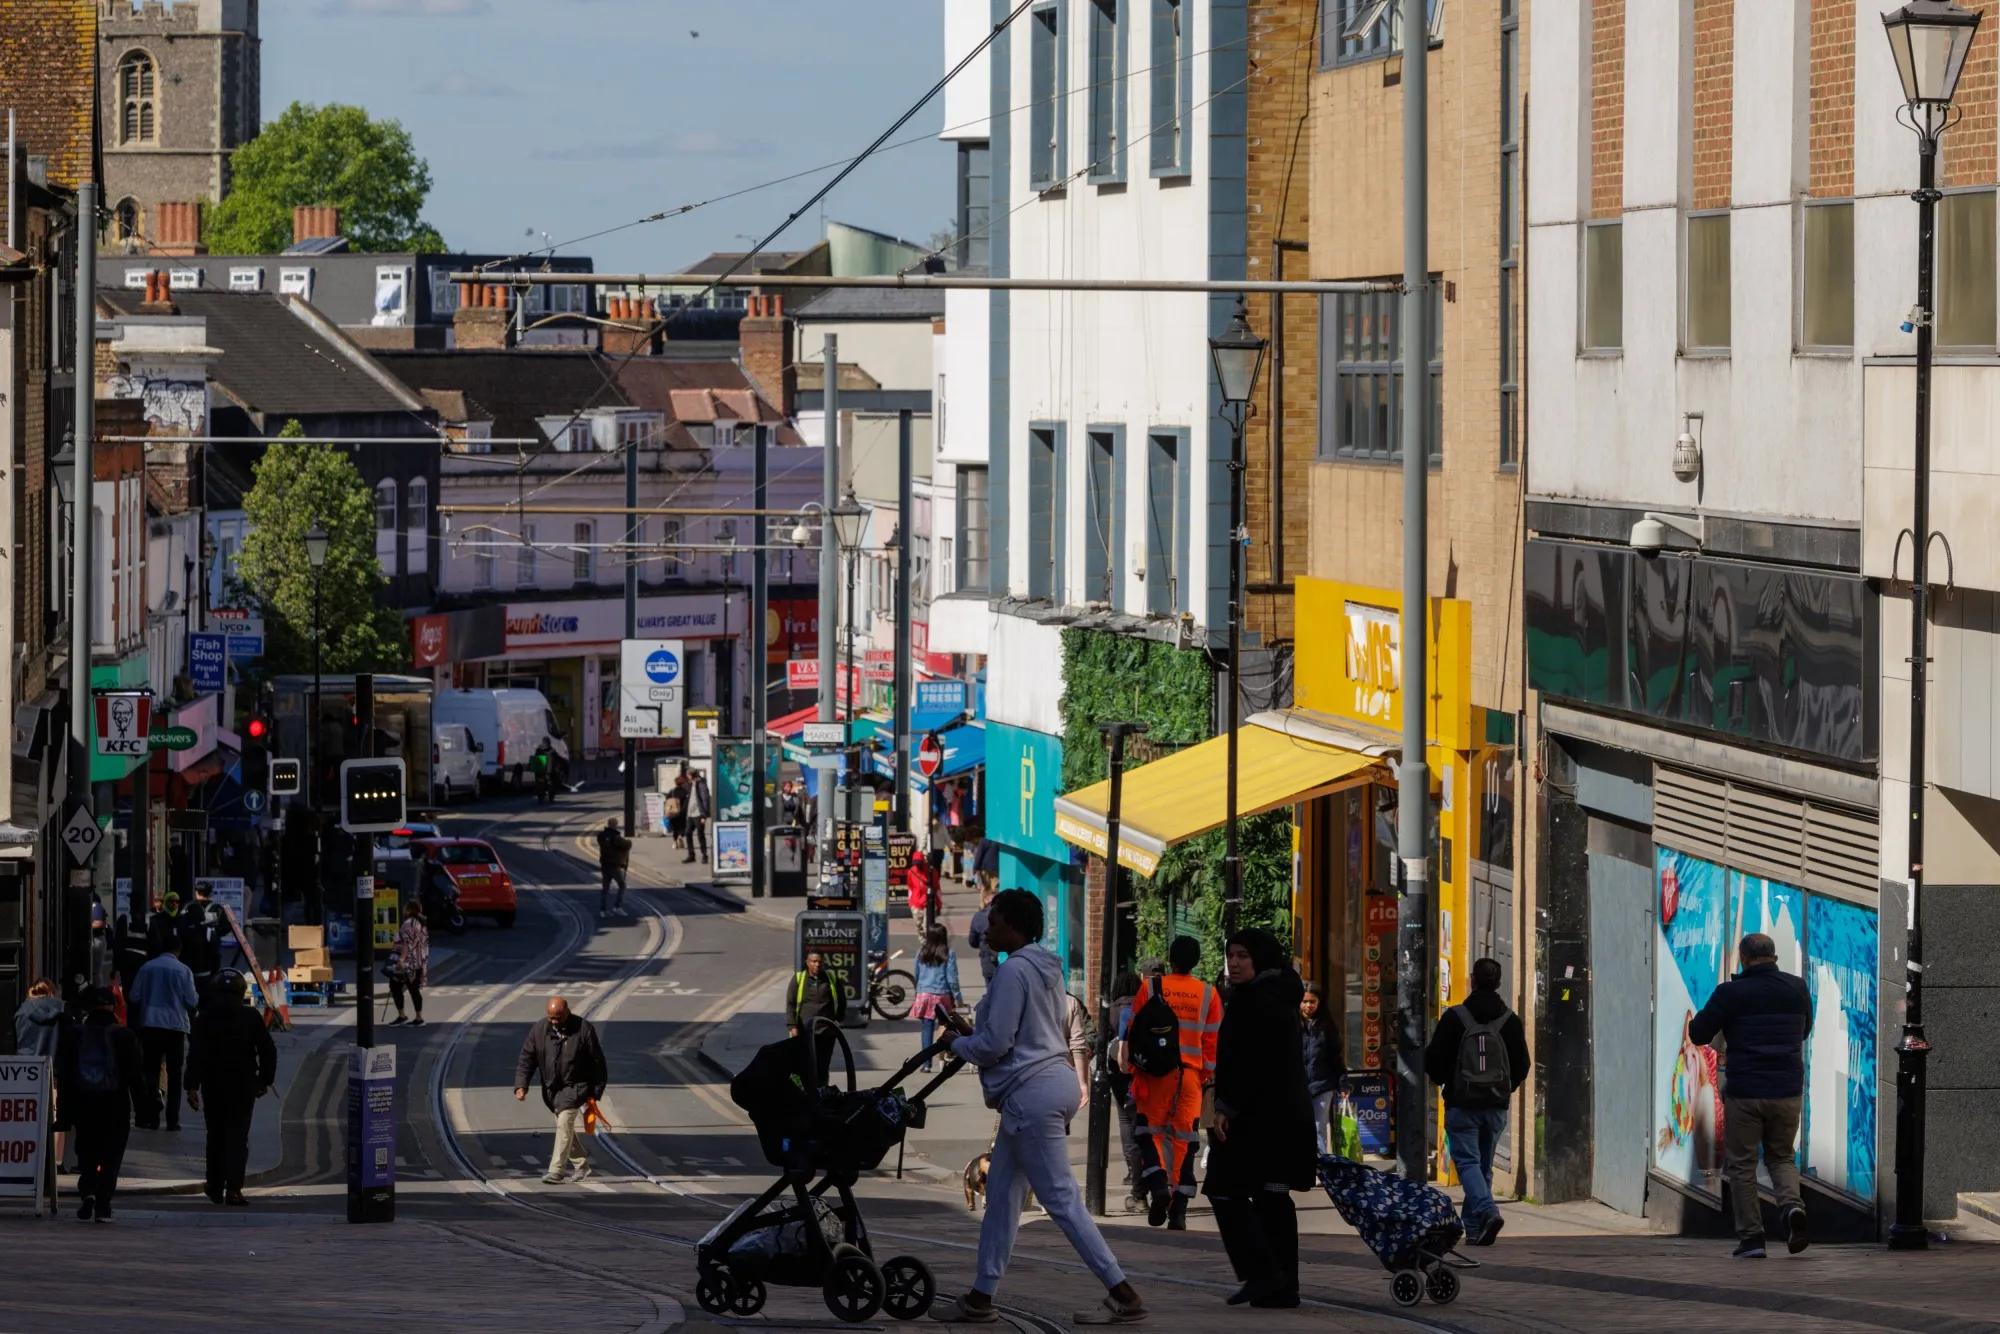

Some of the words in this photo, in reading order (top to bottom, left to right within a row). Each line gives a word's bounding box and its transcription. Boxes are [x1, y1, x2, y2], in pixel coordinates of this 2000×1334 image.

[667, 615, 691, 627] GREAT
[692, 613, 716, 626] VALUE
[220, 621, 244, 634] Lyca
[420, 622, 442, 651] Argos
[195, 639, 220, 650] Fish
[191, 650, 223, 663] Shop
[195, 664, 219, 672] Fresh
[652, 690, 670, 698] Only
[922, 694, 961, 703] FRESH
[624, 715, 637, 723] All
[105, 740, 141, 753] KFC
[1486, 759, 1499, 814] 10
[68, 827, 95, 844] 20
[891, 846, 912, 857] BUY
[1370, 901, 1397, 920] ria
[806, 928, 857, 937] ALBONE
[1361, 1085, 1380, 1093] Lyca
[1358, 1110, 1387, 1121] 20GB
